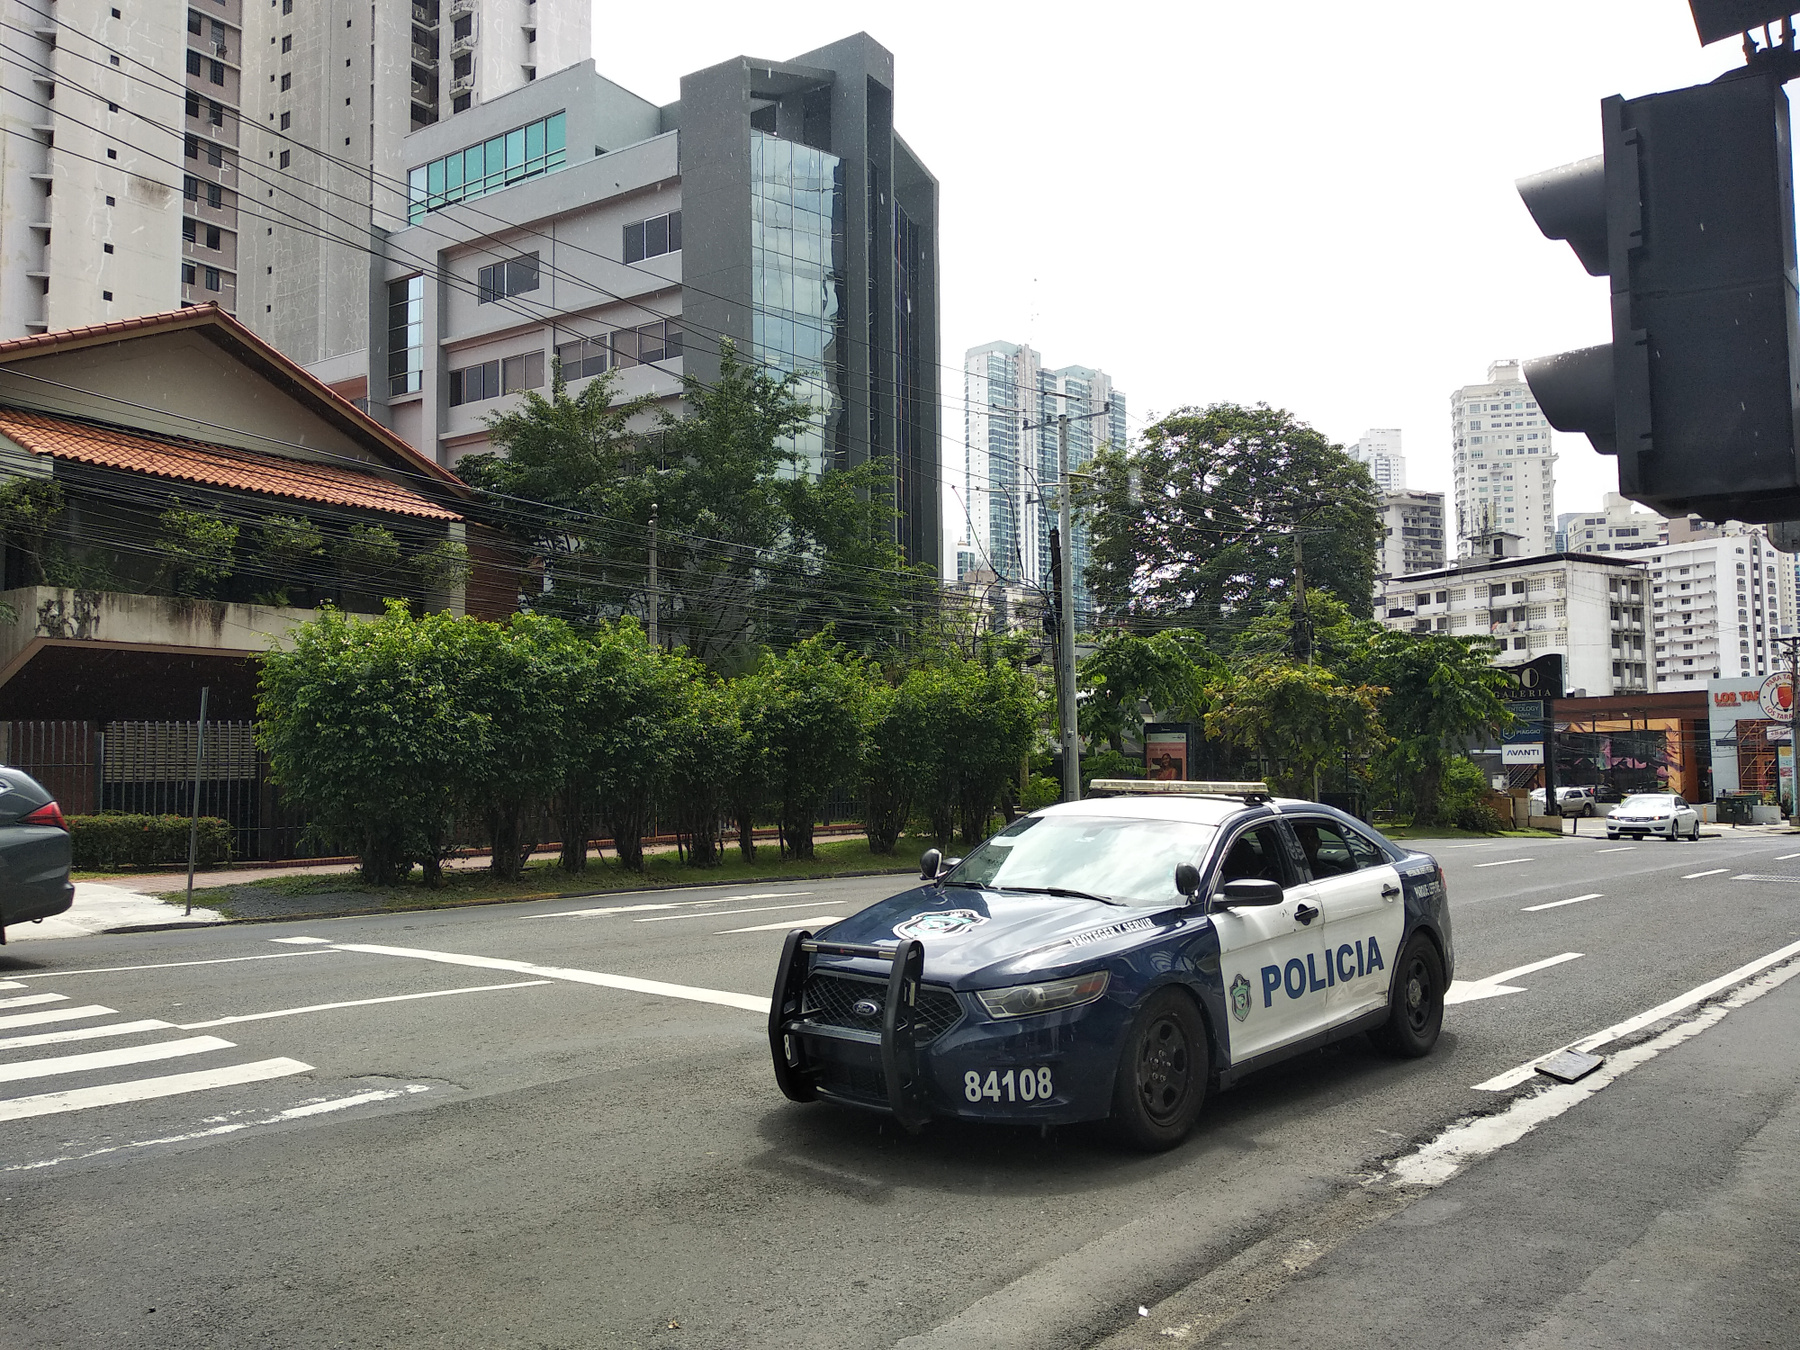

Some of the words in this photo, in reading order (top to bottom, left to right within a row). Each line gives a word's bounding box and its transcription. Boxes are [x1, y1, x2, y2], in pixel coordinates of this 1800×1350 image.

[1766, 675, 1782, 687] PARA
[1494, 689, 1552, 698] GALERIA
[1714, 692, 1736, 702] LOS
[1765, 706, 1775, 716] LOS
[1069, 926, 1118, 948] PROTEGER
[1116, 924, 1124, 934] Y
[1123, 917, 1157, 933] SERVIR
[1260, 935, 1385, 1009] POLICIA
[964, 1066, 1053, 1103] 84108
